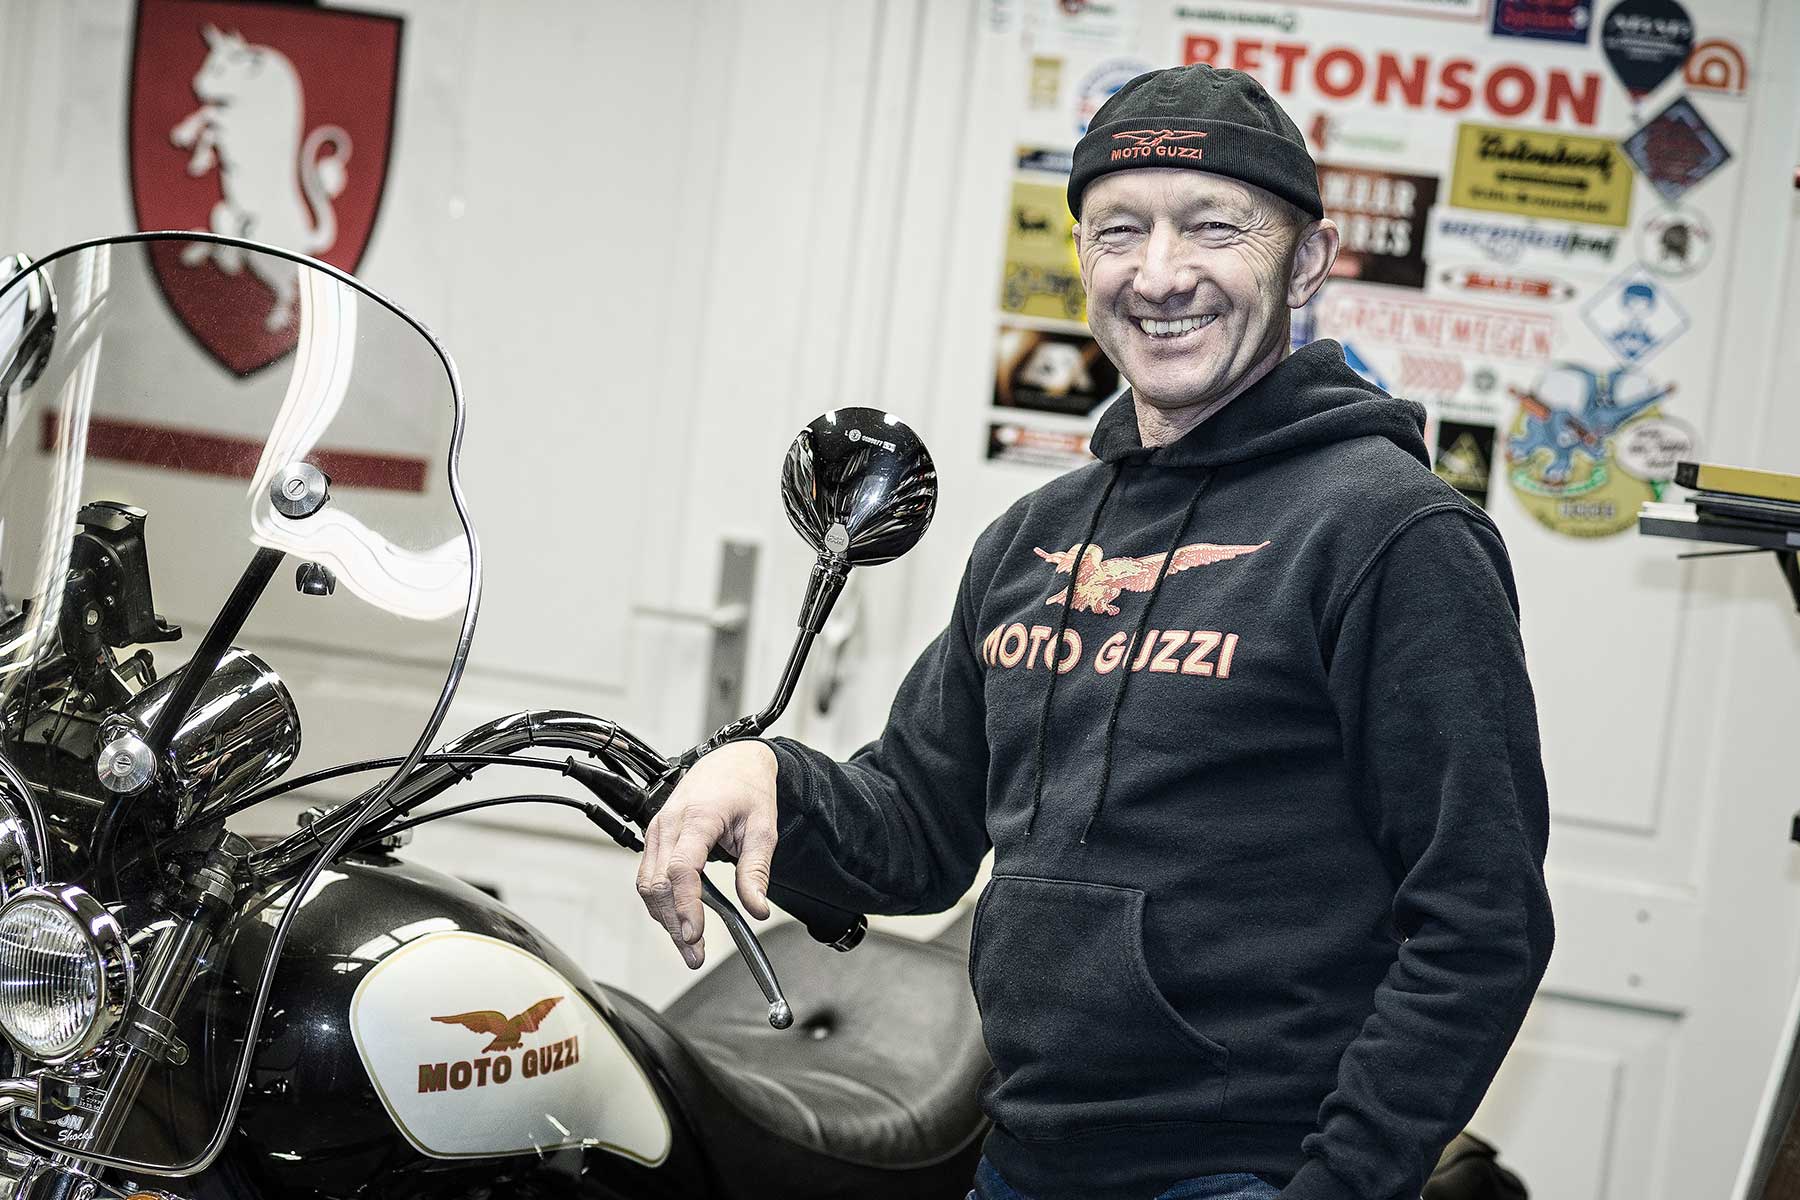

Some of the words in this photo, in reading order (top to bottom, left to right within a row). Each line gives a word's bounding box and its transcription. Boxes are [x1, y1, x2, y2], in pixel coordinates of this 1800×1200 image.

[1183, 34, 1601, 126] BETONSON
[1111, 145, 1151, 161] MOTO
[1155, 145, 1202, 160] GUZZI
[982, 622, 1083, 675] MOTO
[1094, 629, 1239, 679] GUZZI
[418, 1055, 512, 1093] MOTO
[521, 1035, 579, 1078] GUZZI
